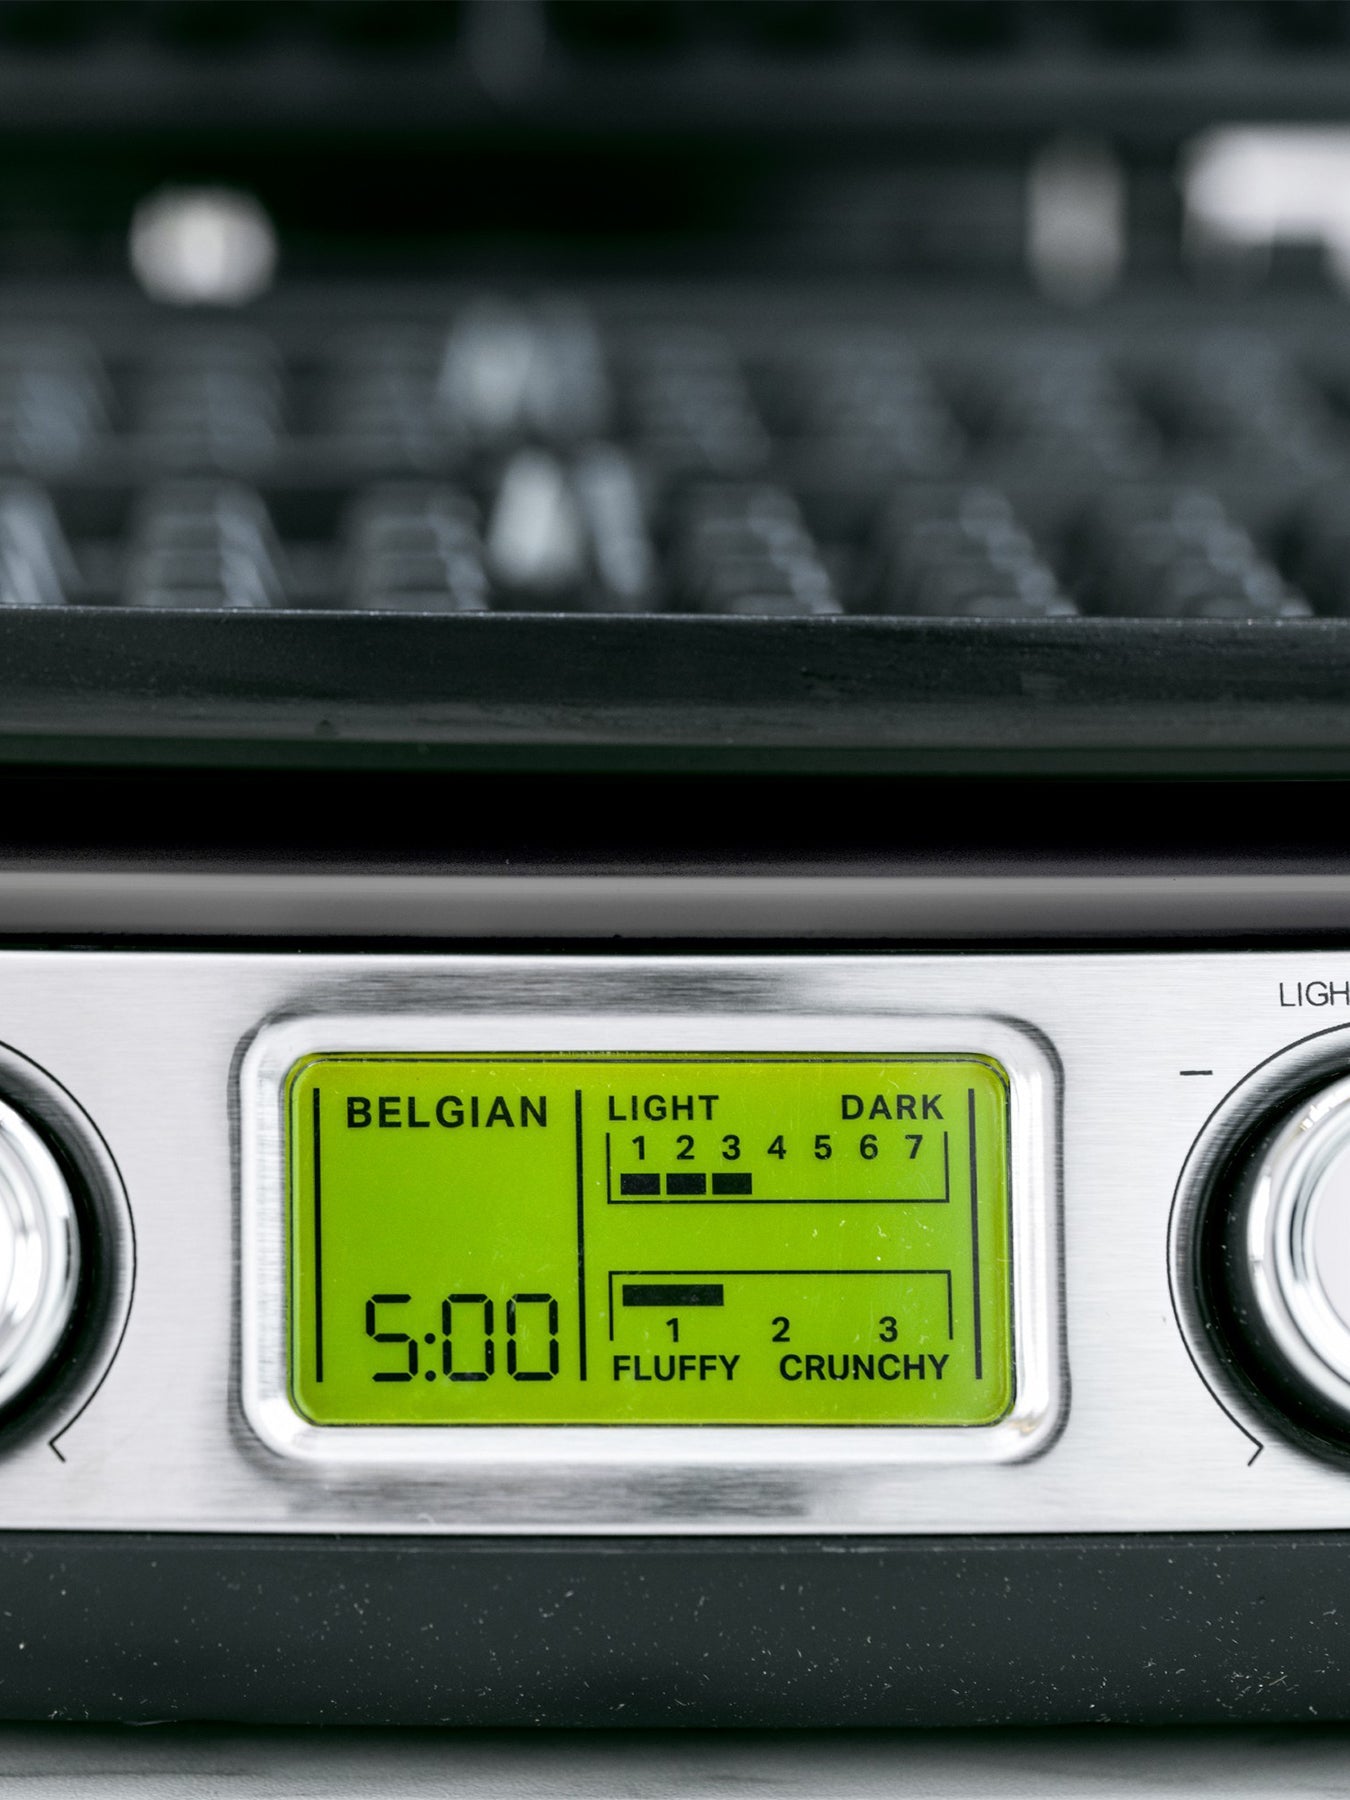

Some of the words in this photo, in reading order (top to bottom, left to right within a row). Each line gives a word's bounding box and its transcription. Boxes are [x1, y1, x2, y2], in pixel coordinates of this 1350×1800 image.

[1279, 981, 1350, 1007] LIGH
[346, 1095, 548, 1129] BELGIAN
[608, 1094, 720, 1122] LIGHT
[841, 1094, 944, 1120] DARK
[632, 1135, 646, 1161] 1
[676, 1134, 695, 1161] 2
[721, 1134, 741, 1161] 3
[767, 1134, 787, 1160] 4
[814, 1134, 833, 1161] 5
[859, 1134, 879, 1161] 6
[905, 1134, 923, 1160] 7
[365, 1293, 560, 1383] 5:00
[665, 1317, 679, 1343] 1
[771, 1316, 791, 1343] 2
[879, 1315, 898, 1343] 3
[613, 1354, 741, 1382] FLUFFY
[779, 1353, 950, 1382] CRUNCHY
